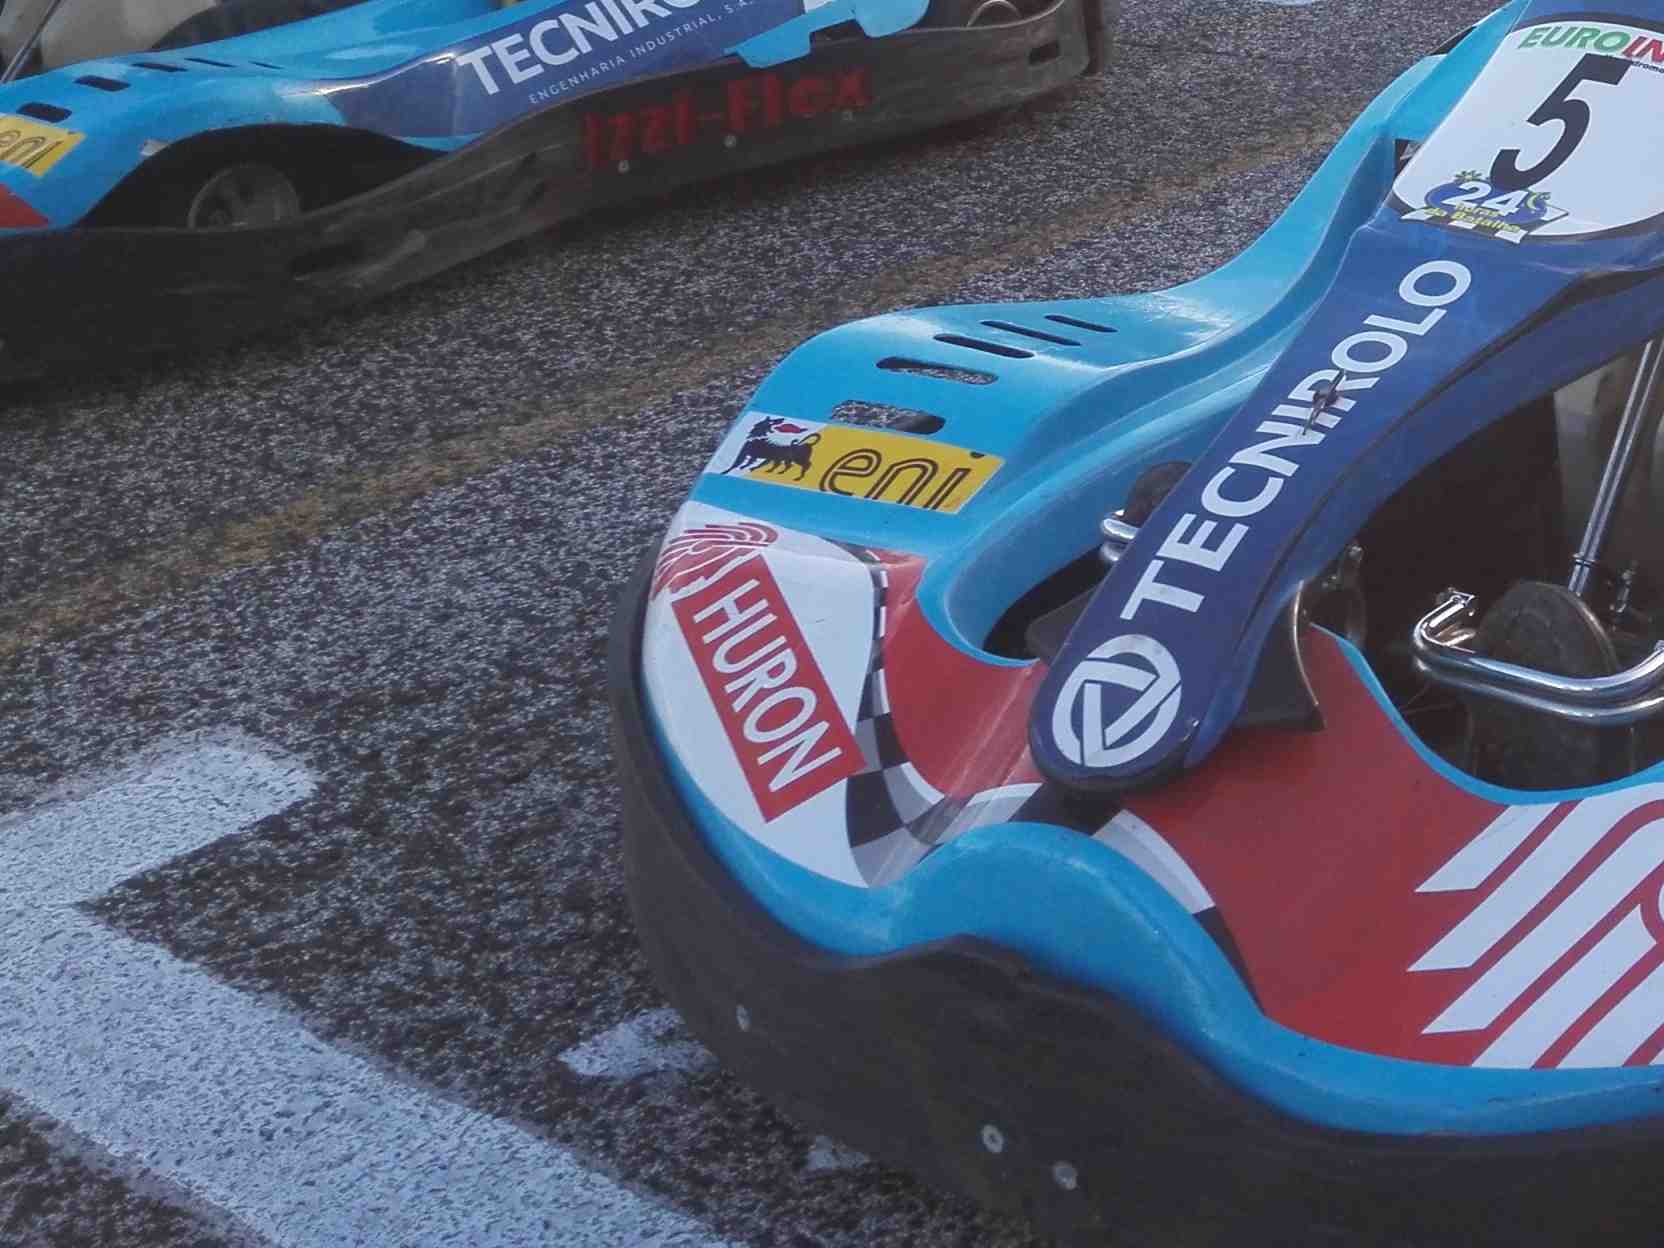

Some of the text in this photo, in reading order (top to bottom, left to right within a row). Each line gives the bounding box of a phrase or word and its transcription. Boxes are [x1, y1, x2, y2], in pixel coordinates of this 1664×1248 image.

[528, 55, 627, 104] ENGENHARIA
[1490, 53, 1631, 189] 5
[1440, 180, 1529, 216] 24
[819, 448, 984, 510] eni
[1120, 260, 1472, 620] TECNIROLO
[693, 578, 844, 792] HURON
